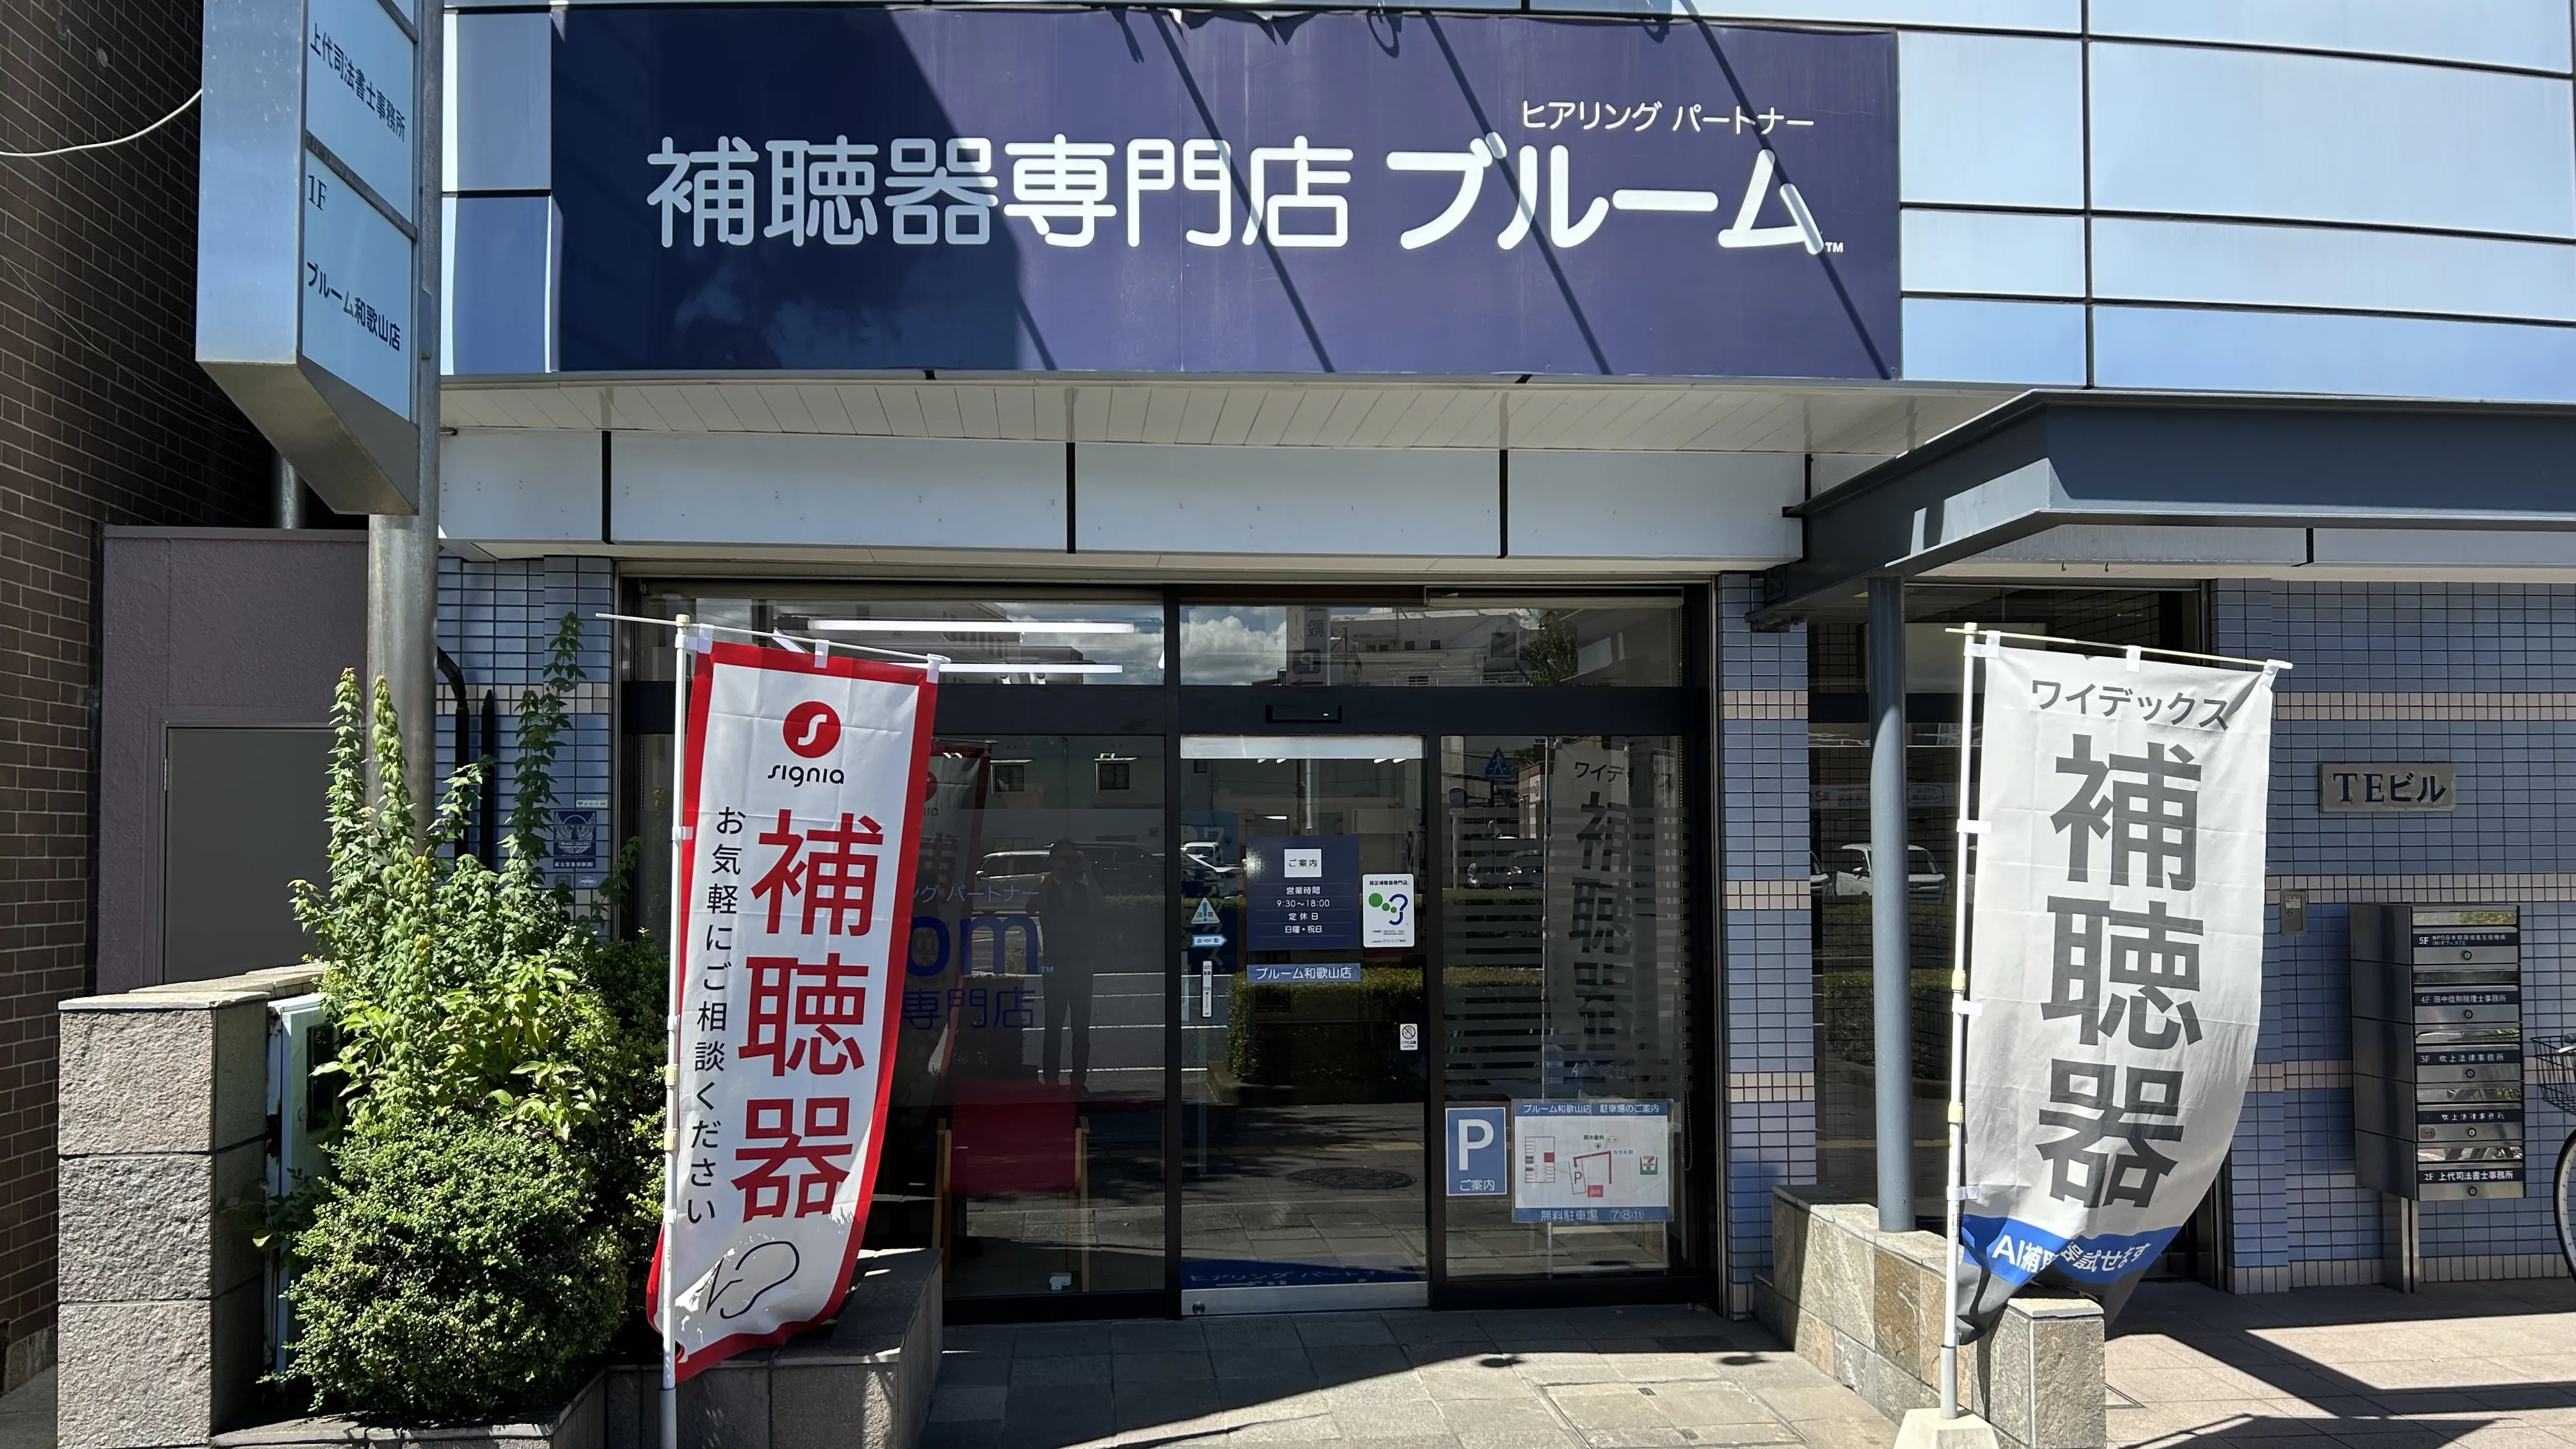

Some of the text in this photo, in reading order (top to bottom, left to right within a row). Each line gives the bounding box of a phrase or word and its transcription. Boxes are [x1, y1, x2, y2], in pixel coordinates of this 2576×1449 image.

[310, 22, 406, 143] 上代司法書士事務所
[1522, 99, 1815, 134] ヒアリング パートナー
[308, 174, 327, 211] 1F
[647, 135, 1354, 249] 補聴器専門店
[1386, 131, 1825, 255] ブルーム
[306, 261, 401, 352] ブルーム和歌山店
[2032, 679, 2229, 731] ワイデックス
[767, 764, 845, 788] signia
[2333, 772, 2446, 803] TEビル
[1288, 859, 1318, 868] ご案内
[947, 884, 1040, 903] パートナー
[1286, 886, 1320, 895] 営業時間
[1288, 913, 1319, 922] 定休日
[2419, 936, 2429, 945] 5F
[1256, 967, 1352, 980] ブルーム和歌山店
[2036, 733, 2204, 1209] 補聴器
[687, 806, 746, 1224] お気軽にご相談ください
[731, 809, 883, 1222] 補聴器
[2420, 1055, 2431, 1063] 3F
[1523, 1104, 1659, 1113] ブルーム和歌山店 駐車場のご案内
[1458, 1119, 1494, 1170] P
[1459, 1179, 1495, 1191] ご案内
[2438, 1170, 2514, 1181] 上代司法書士事務所
[1540, 1209, 1599, 1221] 無料駐車場
